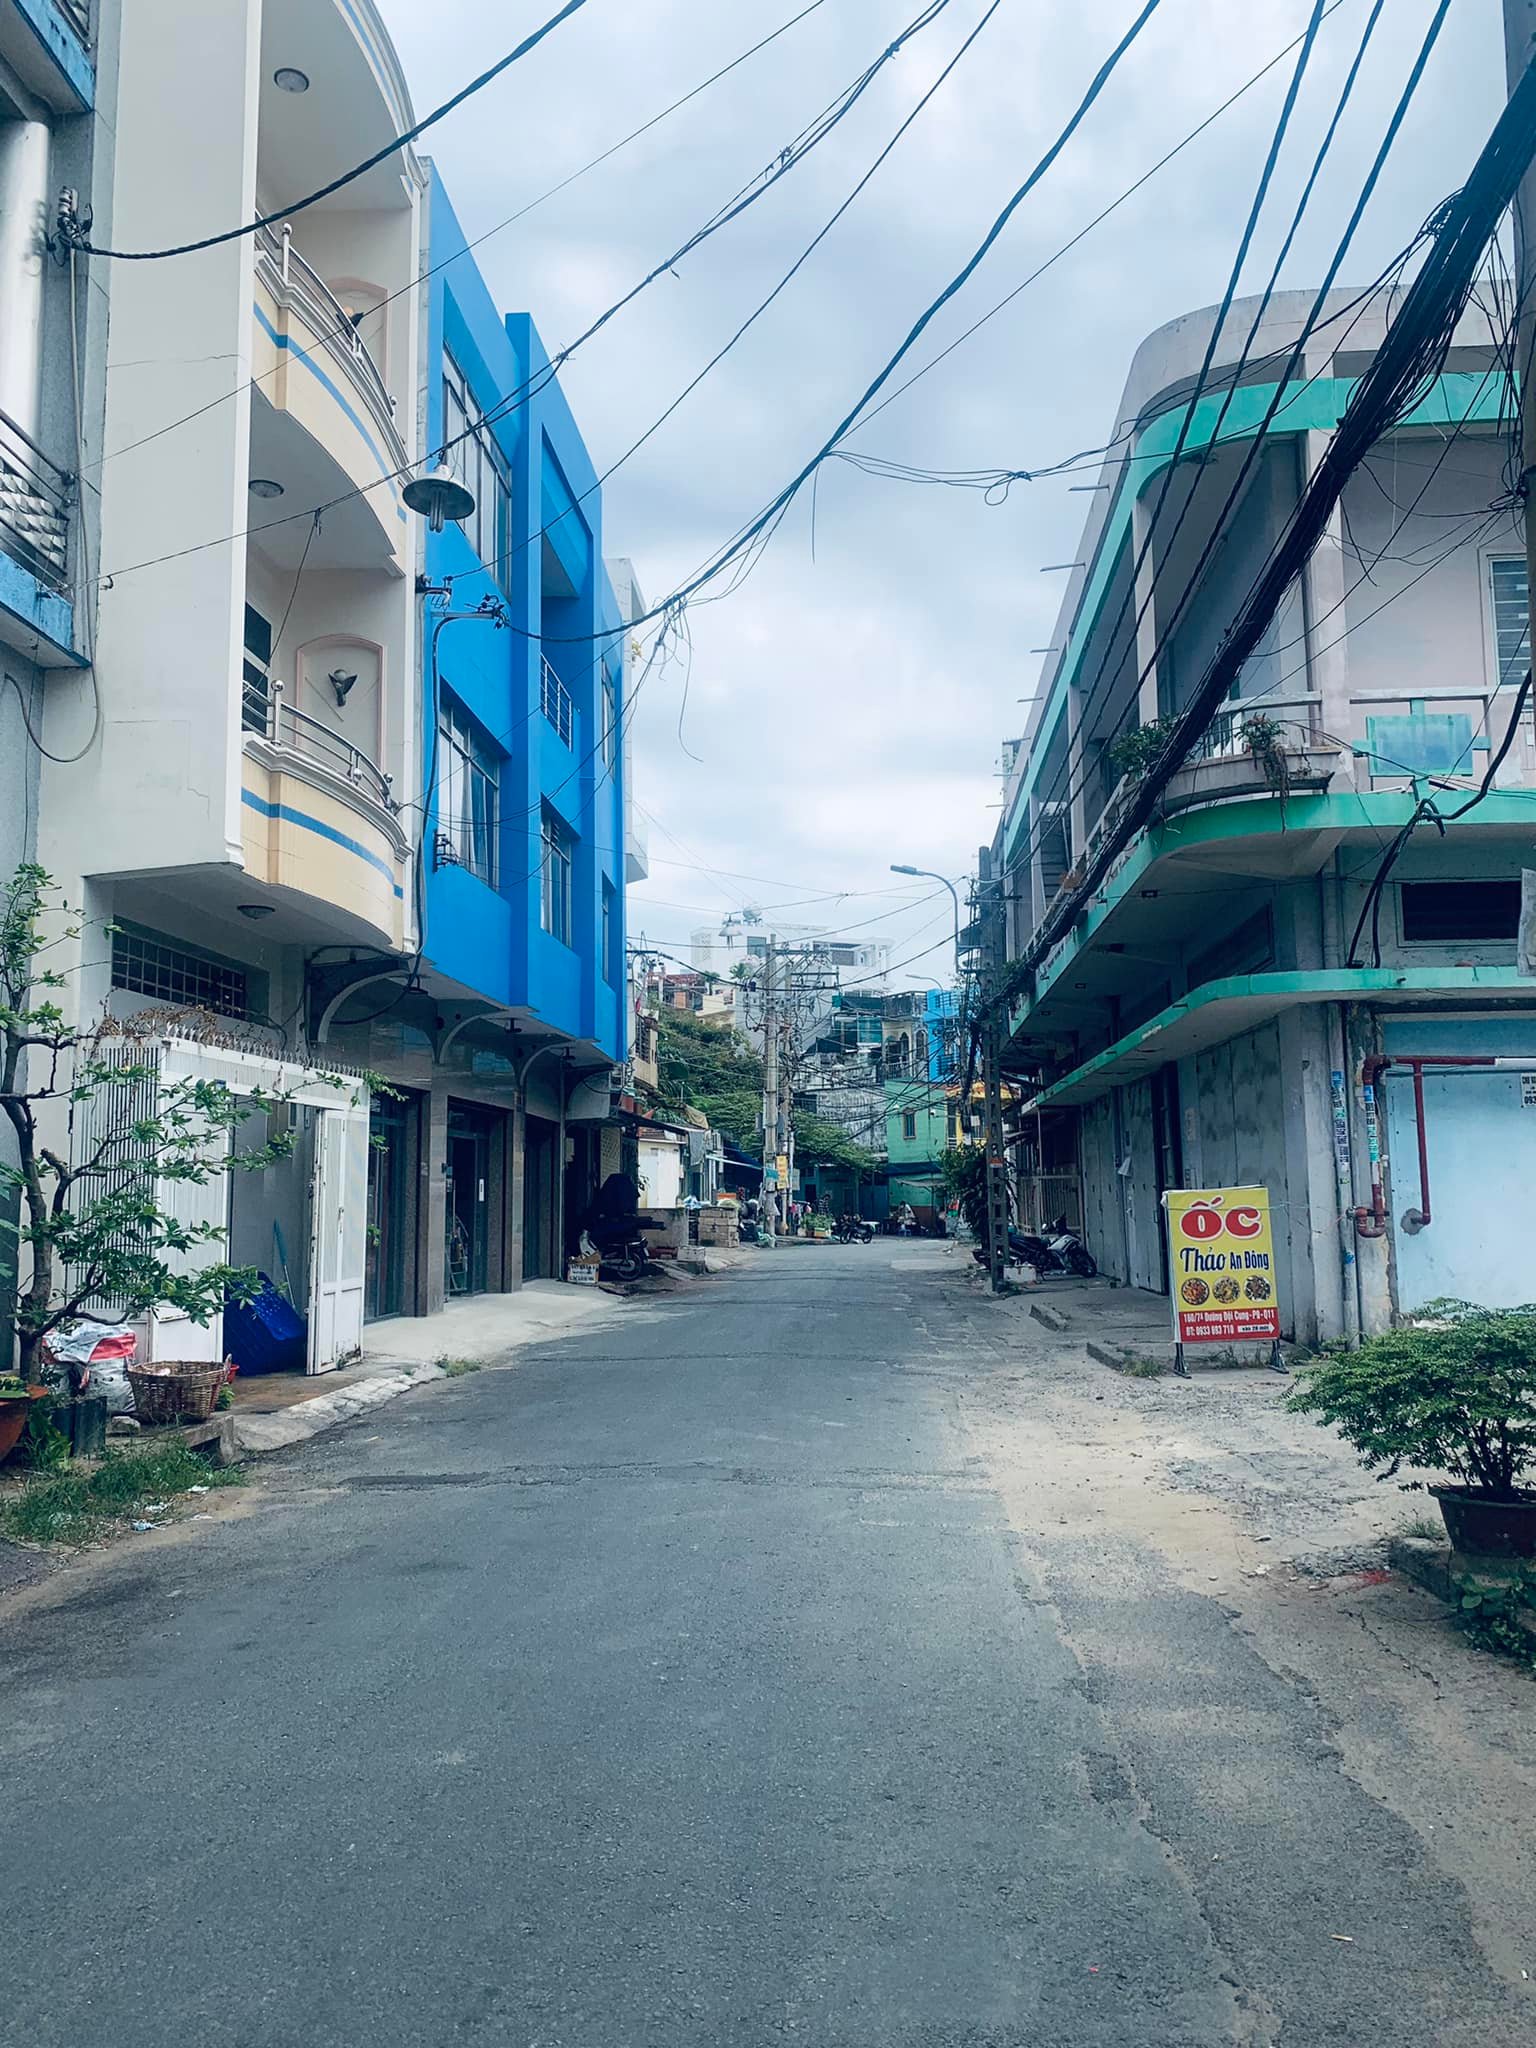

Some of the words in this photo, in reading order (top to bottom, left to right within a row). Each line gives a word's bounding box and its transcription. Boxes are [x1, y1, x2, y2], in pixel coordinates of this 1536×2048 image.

[1180, 1196, 1261, 1240] ỐC
[1180, 1246, 1226, 1272] Thảo
[1230, 1252, 1242, 1270] An
[1244, 1250, 1269, 1270] Đông
